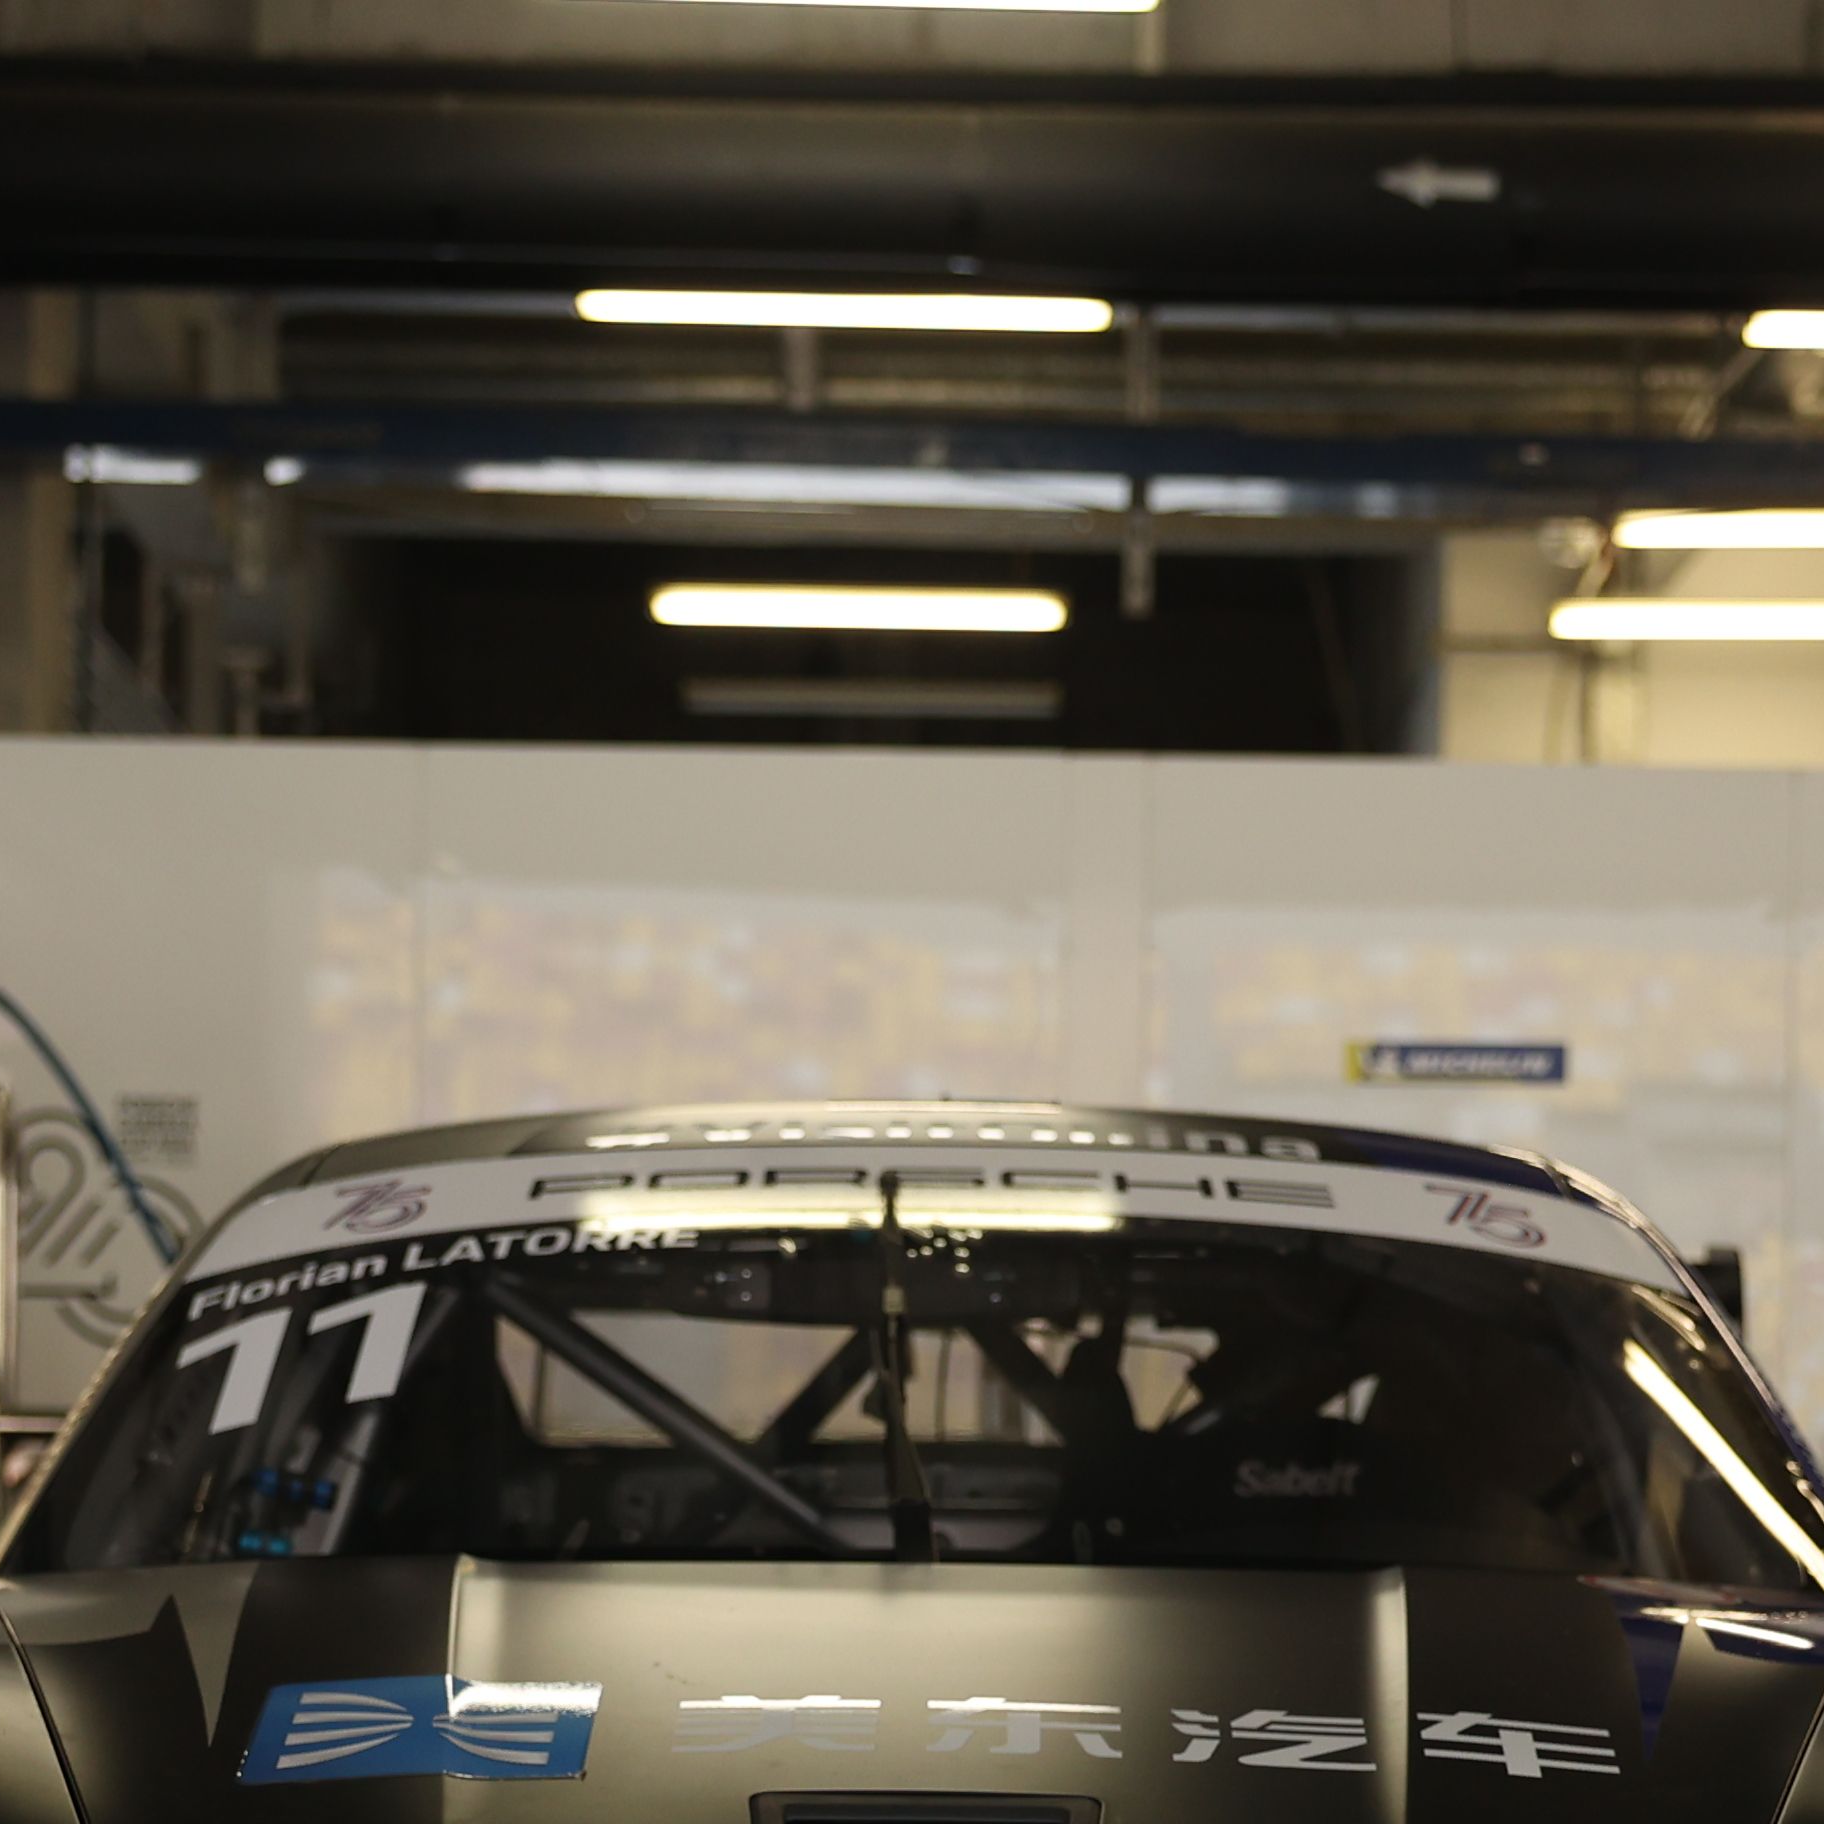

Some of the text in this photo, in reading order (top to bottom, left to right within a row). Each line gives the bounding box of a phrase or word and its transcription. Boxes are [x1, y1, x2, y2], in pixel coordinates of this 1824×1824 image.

[530, 1166, 1336, 1208] PORSCHE
[187, 1226, 701, 1321] Florian LATORRE
[177, 1281, 428, 1436] 11
[670, 1694, 1622, 1779] 美东汽车
